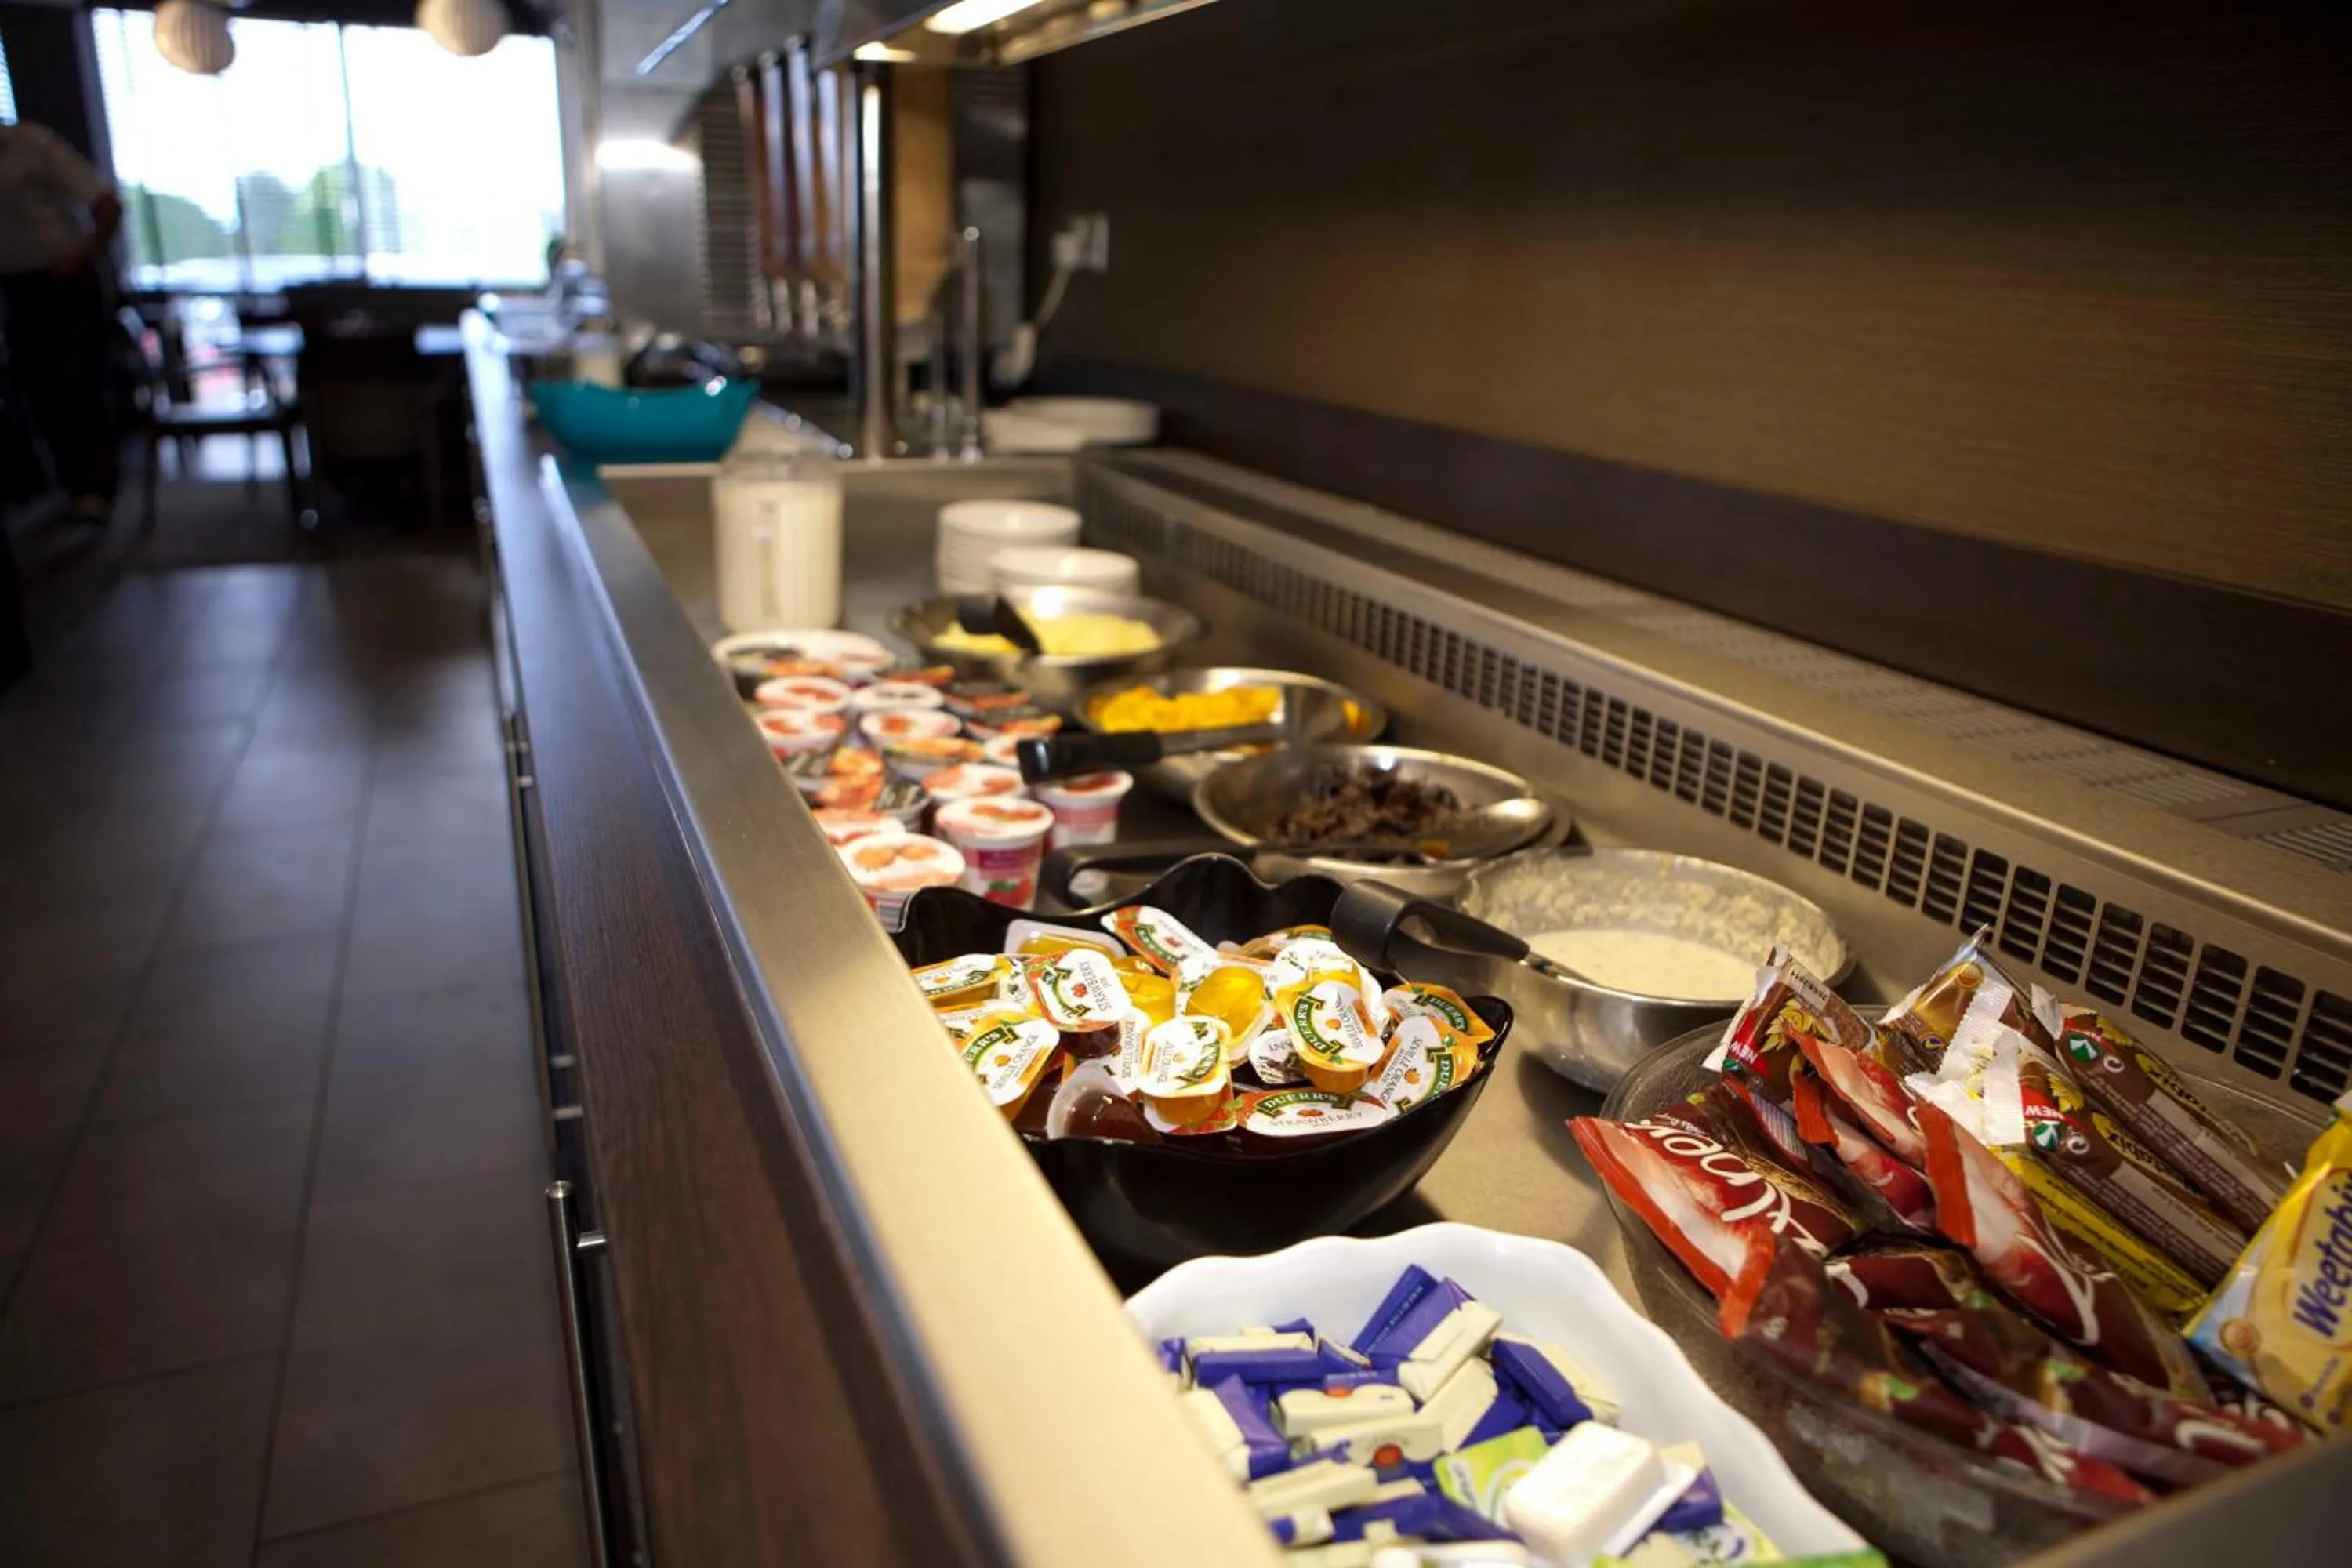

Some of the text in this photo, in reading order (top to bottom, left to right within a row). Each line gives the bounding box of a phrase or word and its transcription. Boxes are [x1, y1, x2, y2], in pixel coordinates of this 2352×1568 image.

[1298, 1002, 1327, 1051] DUERR'S
[1729, 1040, 1759, 1065] NEW
[1263, 1092, 1339, 1108] DUERR'S
[2292, 1171, 2352, 1338] Weetabi
